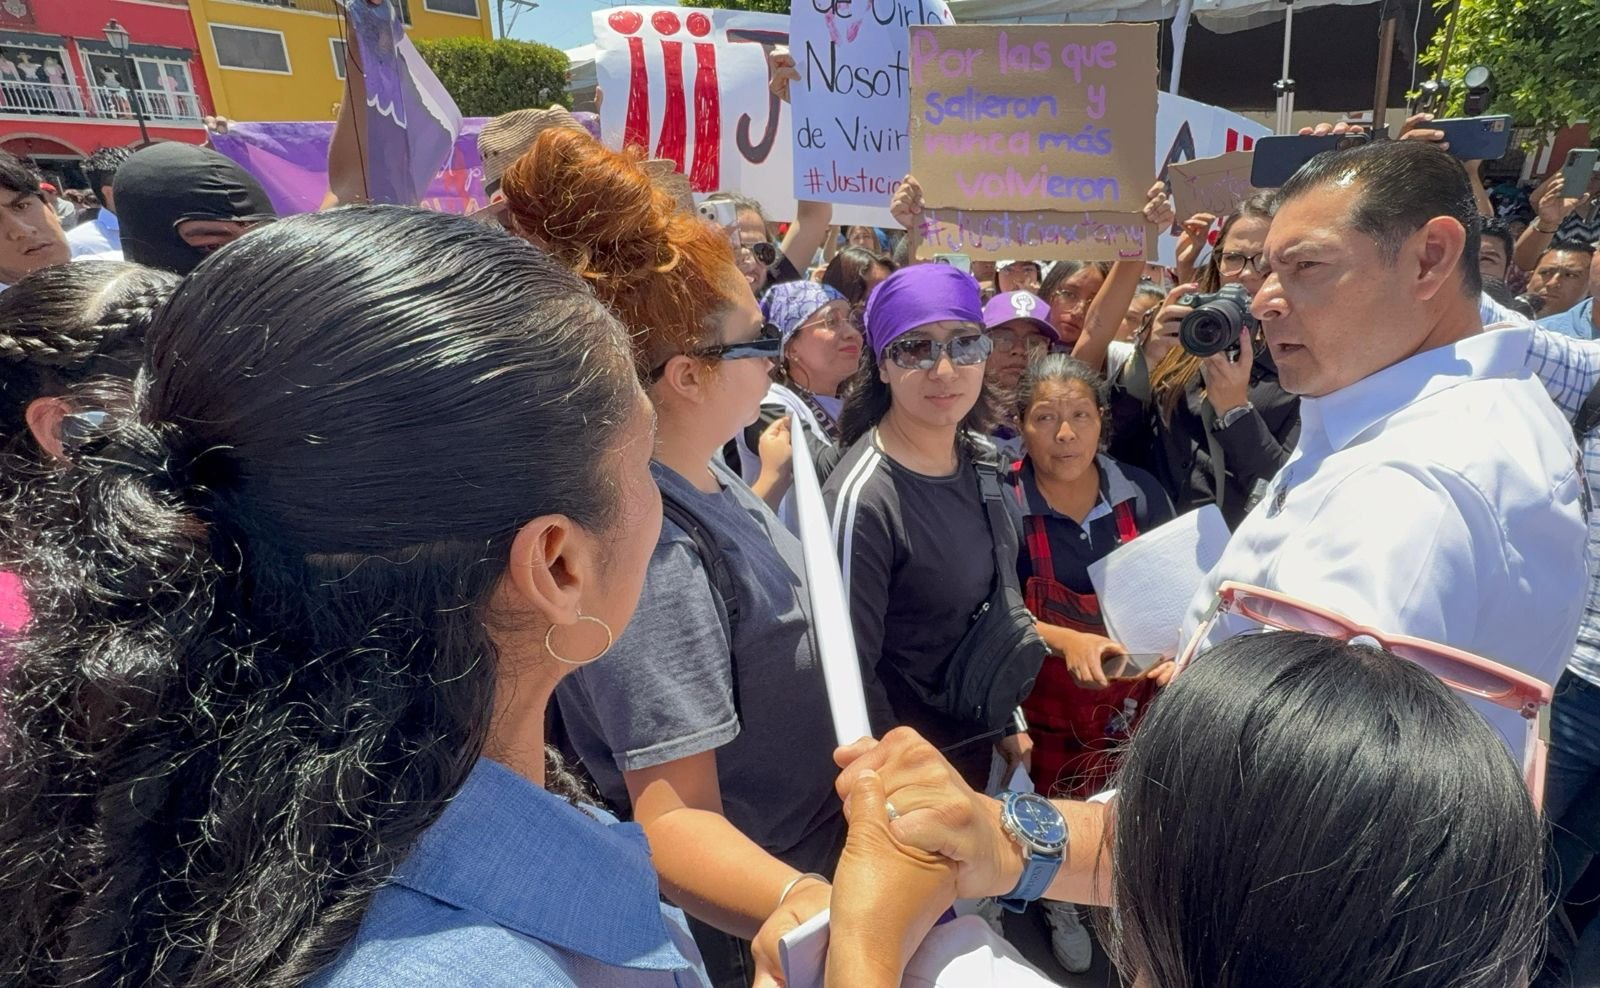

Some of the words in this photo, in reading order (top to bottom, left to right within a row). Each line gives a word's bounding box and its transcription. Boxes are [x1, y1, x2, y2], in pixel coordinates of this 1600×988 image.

[912, 29, 985, 87] Por
[999, 31, 1053, 76] las
[1061, 40, 1117, 83] que
[1086, 84, 1106, 120] y
[797, 117, 826, 149] de
[834, 116, 909, 152] Vivir
[925, 130, 1030, 157] nunca
[1038, 124, 1113, 156] más
[955, 164, 1121, 203] volvieron
